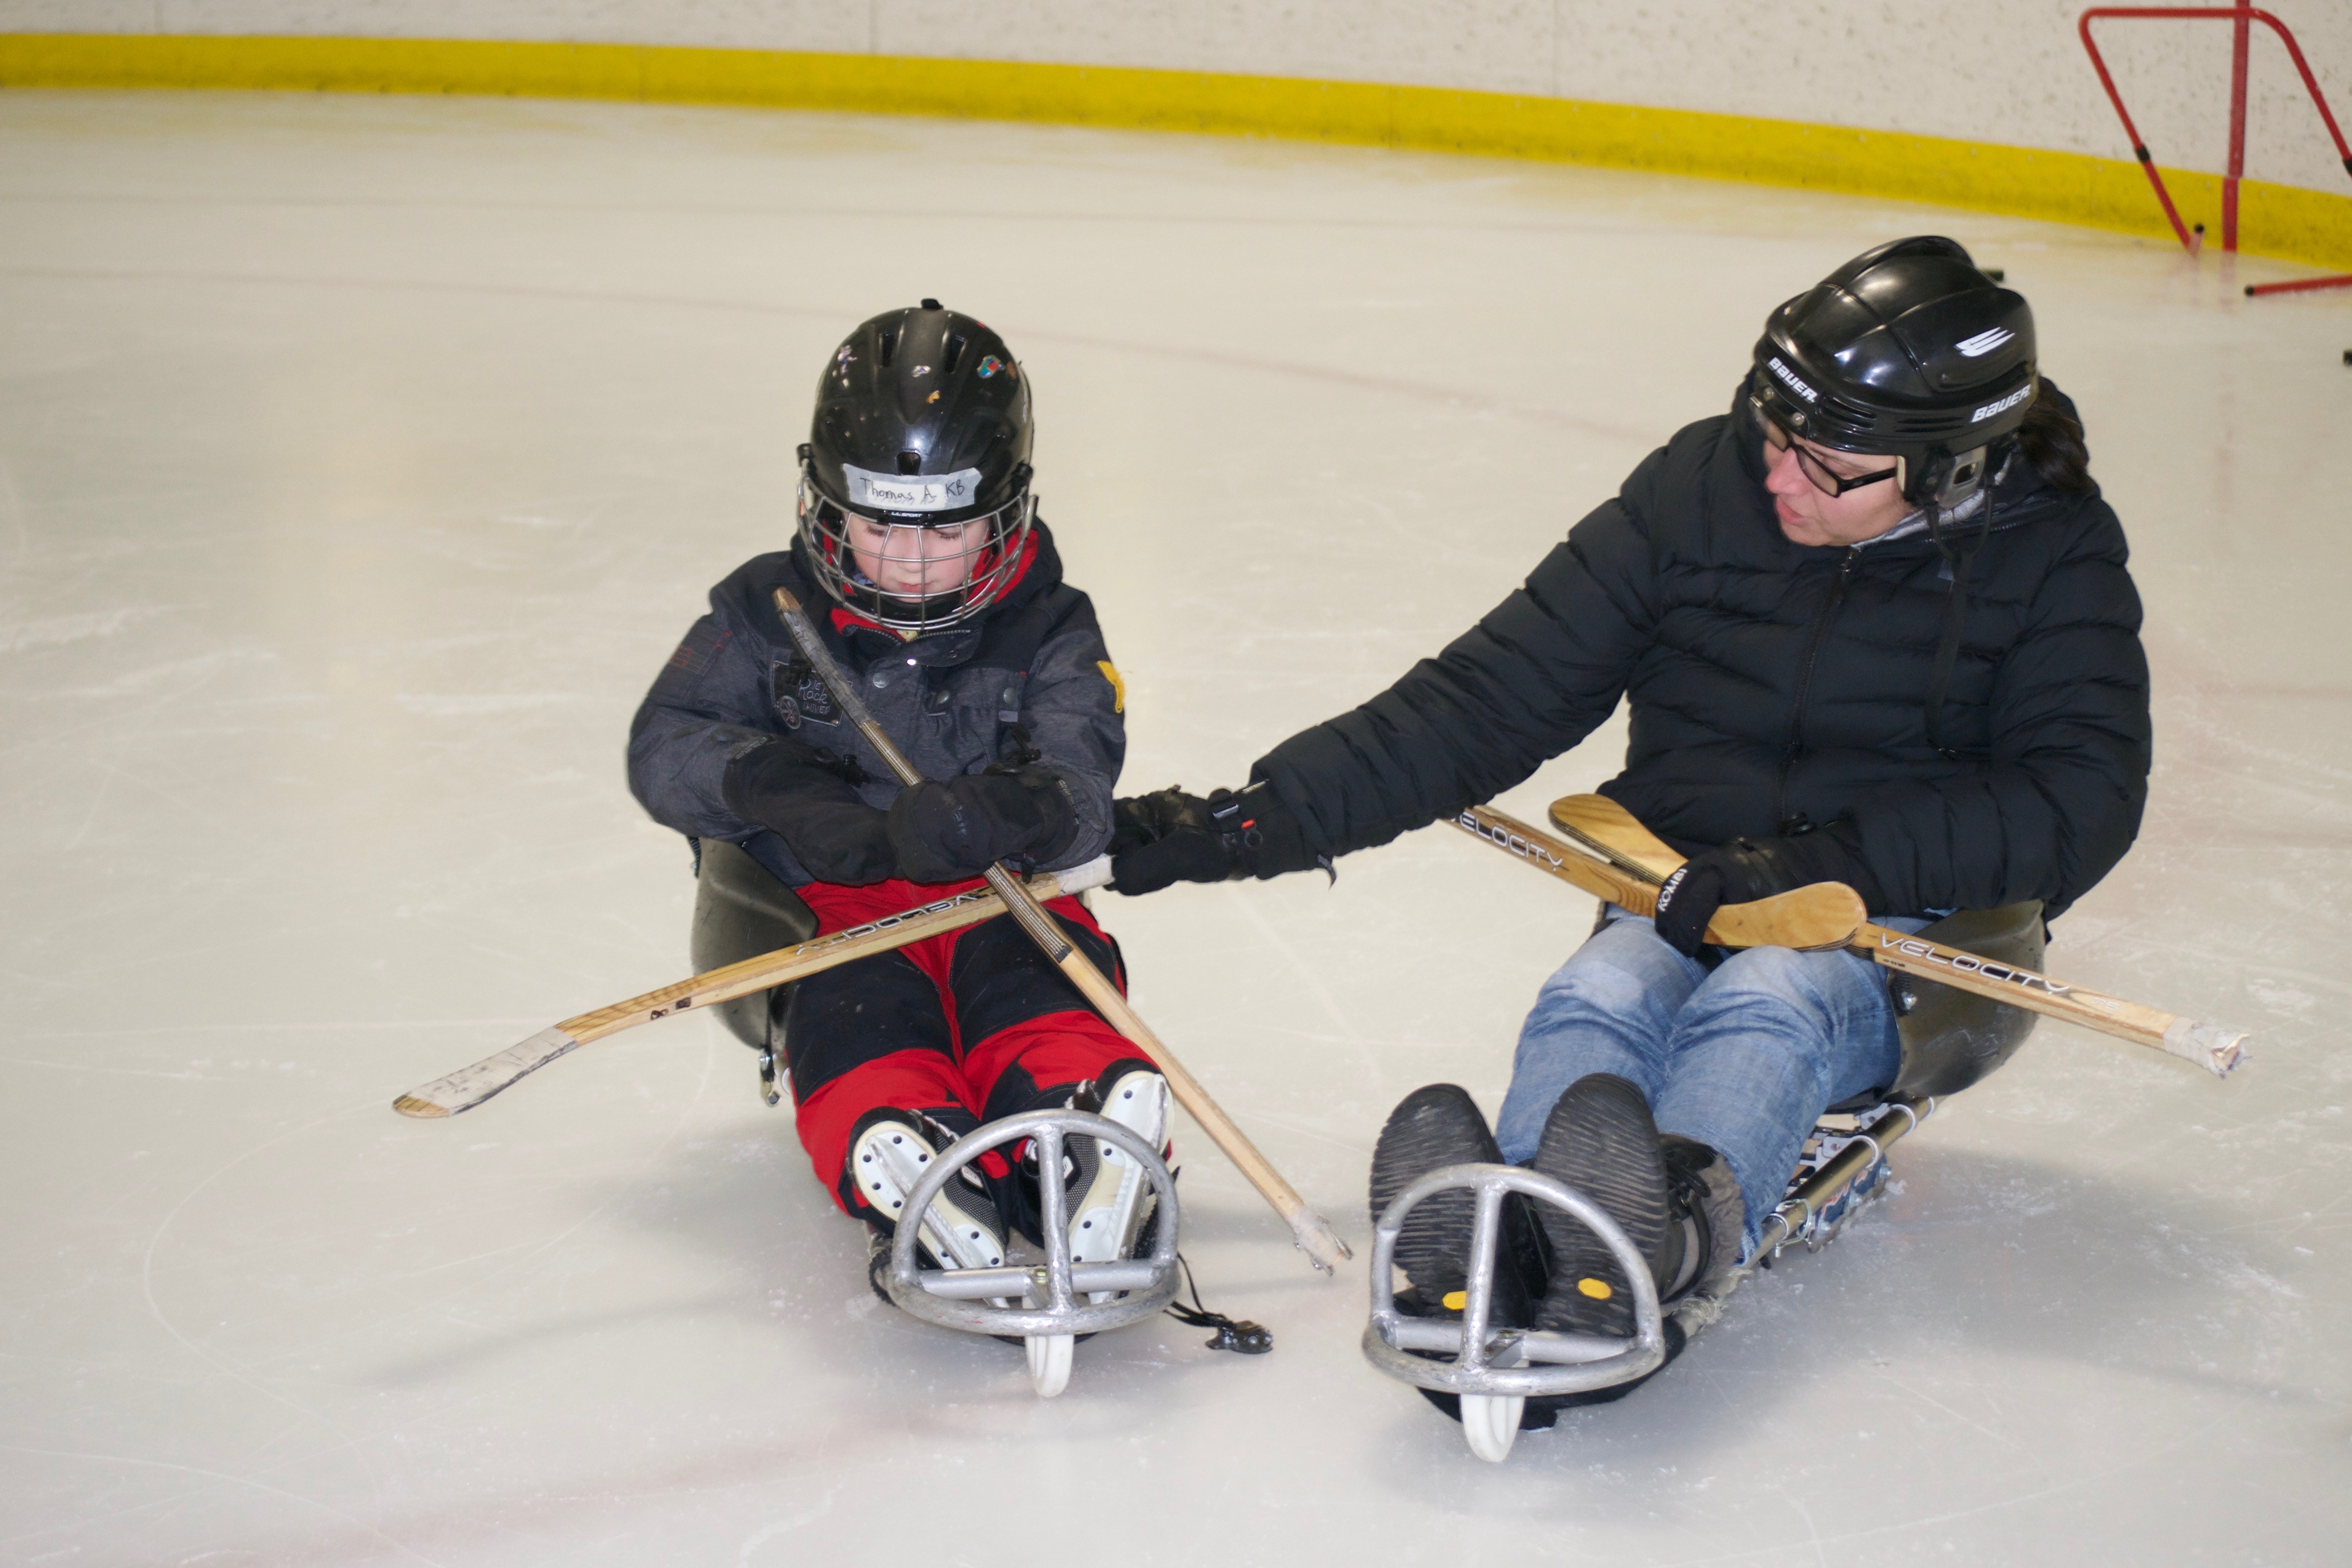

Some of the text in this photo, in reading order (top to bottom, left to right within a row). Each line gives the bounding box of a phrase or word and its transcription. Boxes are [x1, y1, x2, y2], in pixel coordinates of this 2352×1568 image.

[860, 477, 913, 501] Thomas
[945, 479, 965, 498] KB
[1451, 812, 1562, 872] ELOCITY
[1657, 868, 1688, 912] KOMBI
[796, 894, 978, 955] VELOCITY
[1881, 933, 2070, 996] VELOCITY
